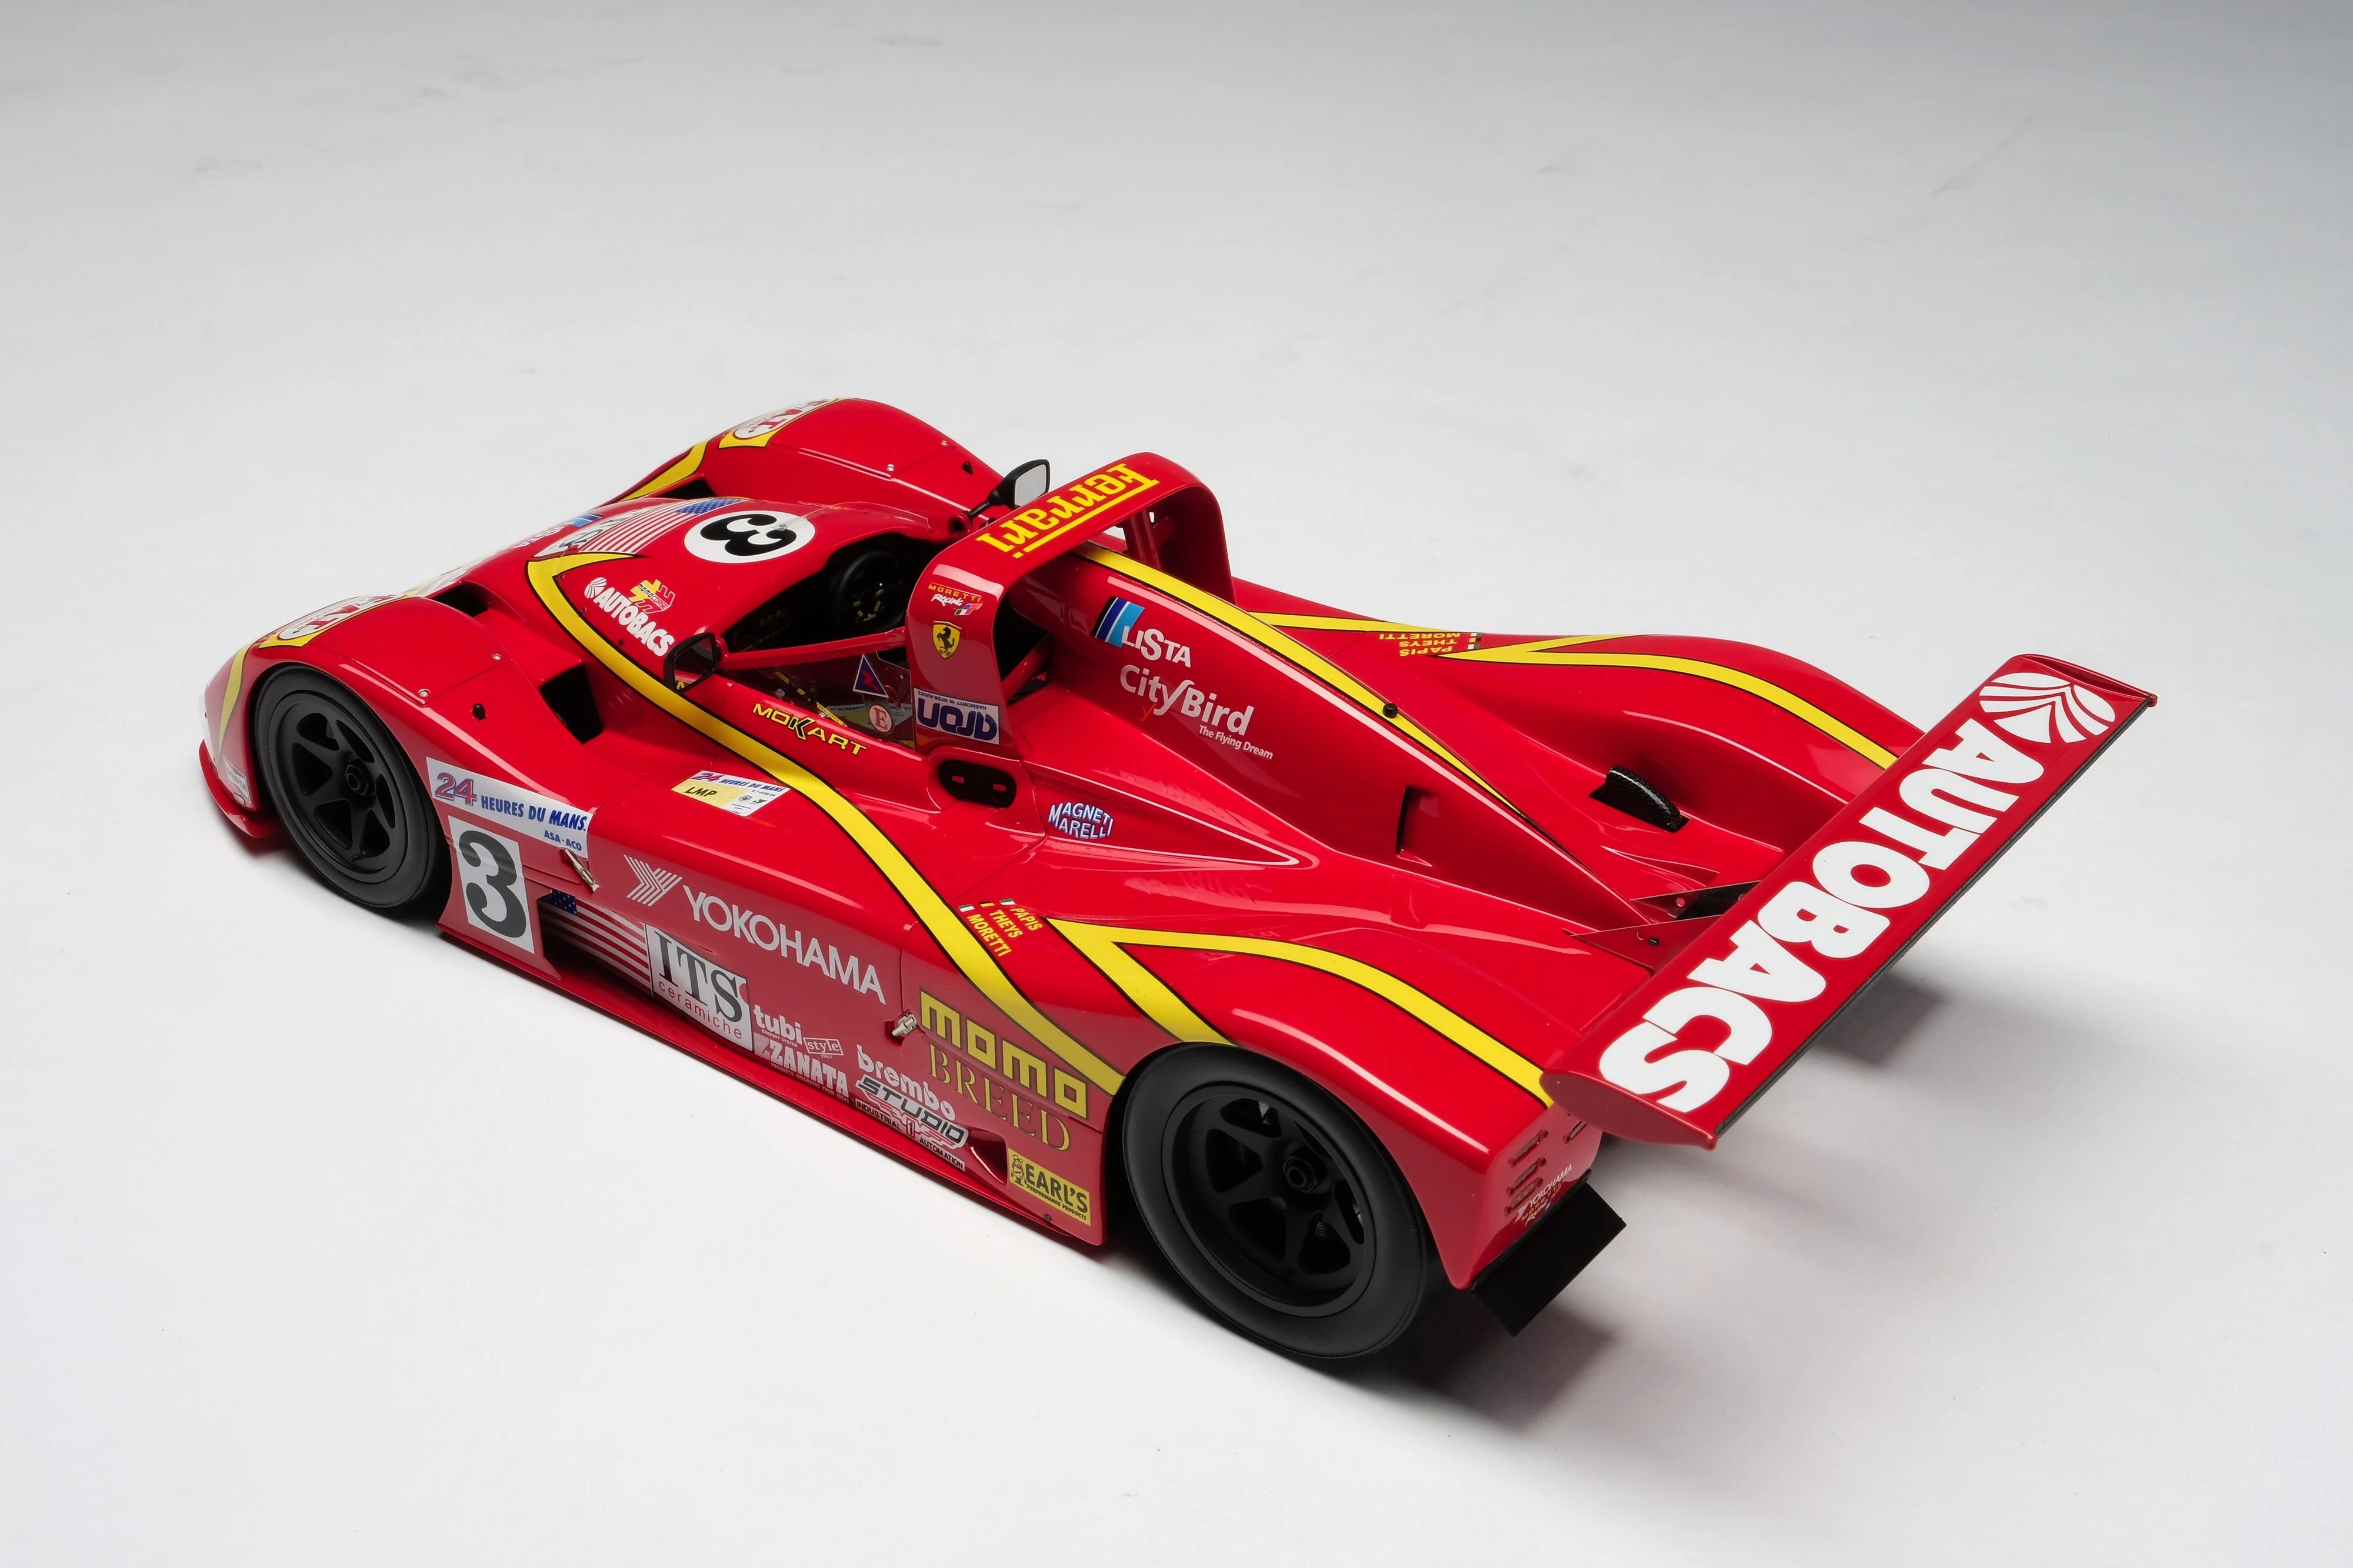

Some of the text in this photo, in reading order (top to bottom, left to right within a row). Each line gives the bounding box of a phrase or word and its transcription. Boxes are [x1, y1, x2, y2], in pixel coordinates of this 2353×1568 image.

[975, 463, 1160, 559] Ferrari
[700, 513, 798, 557] 3
[928, 583, 981, 603] MORETTI
[592, 587, 675, 657] AUTOBACS
[1379, 632, 1461, 640] MORETTI
[1399, 639, 1457, 648] THEYS
[1122, 625, 1191, 668] LISTA
[1399, 646, 1453, 657] PAPIS
[874, 707, 888, 730] E
[1120, 664, 1255, 736] CityBird
[753, 703, 868, 755] MOKART
[1199, 724, 1274, 759] The Flying Dream
[435, 772, 477, 806] 24
[481, 795, 525, 818] HEURES
[528, 805, 546, 822] DU
[685, 786, 718, 798] LMP
[1048, 802, 1114, 828] MAGNETI
[459, 830, 527, 938] 3
[966, 913, 1012, 958] MORETTI
[989, 909, 1024, 939] THEYS
[1009, 908, 1044, 931] PAPIS
[1599, 718, 2045, 1113] AUTOBACS
[682, 885, 886, 1005] YOKOHAMA
[655, 930, 742, 1023] ITS
[659, 981, 742, 1040] ceramiche
[754, 1004, 803, 1045] tubi
[807, 1039, 840, 1053] style
[856, 1044, 956, 1122] brembo
[928, 1043, 1071, 1151] BREED
[856, 1100, 902, 1131] INDUSTRIAL
[858, 1076, 965, 1145] STUDIO
[919, 1136, 964, 1169] AUTOMATION
[1025, 1163, 1088, 1213] EARL'S
[1026, 1185, 1088, 1221] PERFORMANCE PRODUCTS
